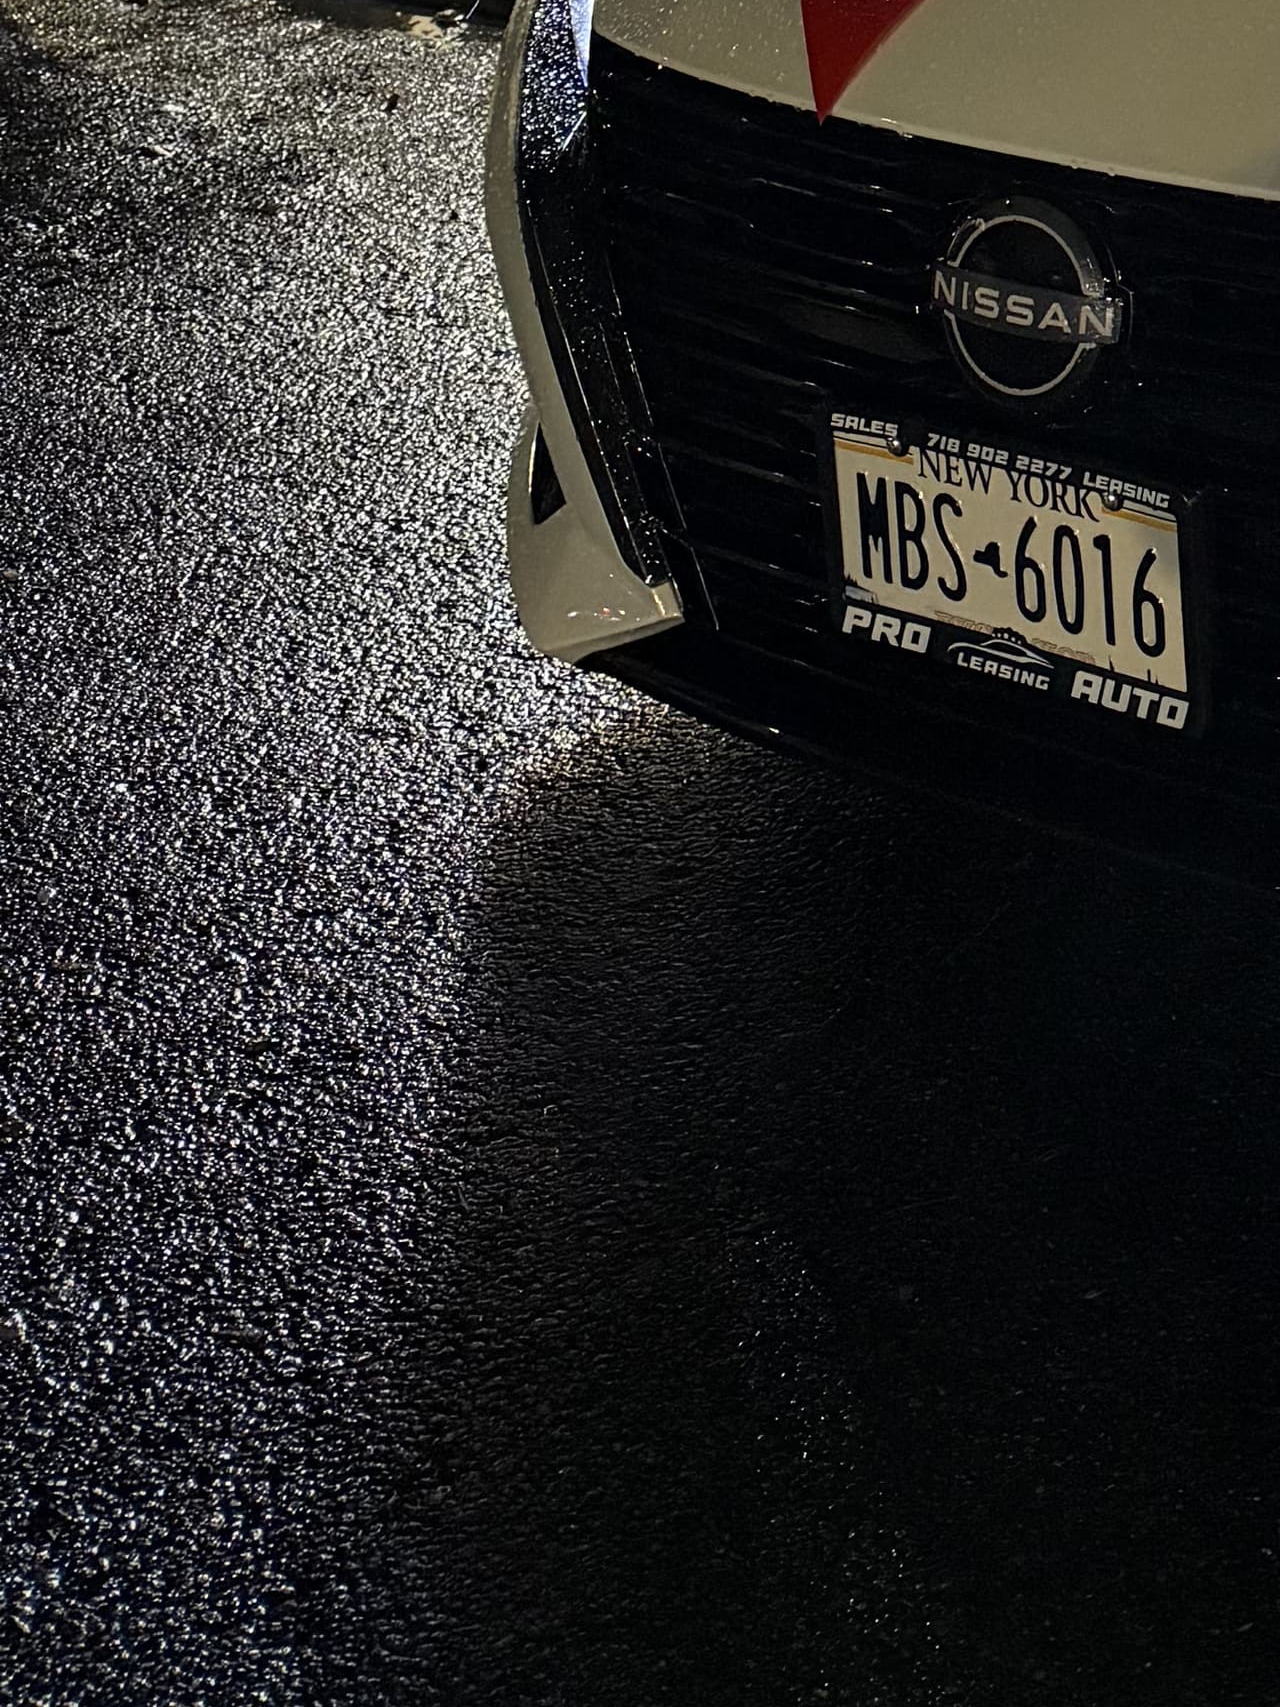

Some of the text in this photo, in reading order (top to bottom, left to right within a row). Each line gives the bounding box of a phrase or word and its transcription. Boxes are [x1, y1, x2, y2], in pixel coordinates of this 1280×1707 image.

[934, 270, 1114, 337] NISSAN
[830, 413, 1171, 509] SALES 718 902 2277 LEASING
[914, 447, 1101, 523] NEW YORK
[856, 471, 1166, 658] MBS 6016
[842, 605, 931, 654] PRO
[957, 652, 1051, 691] LEASING
[1070, 669, 1190, 730] AUTO
